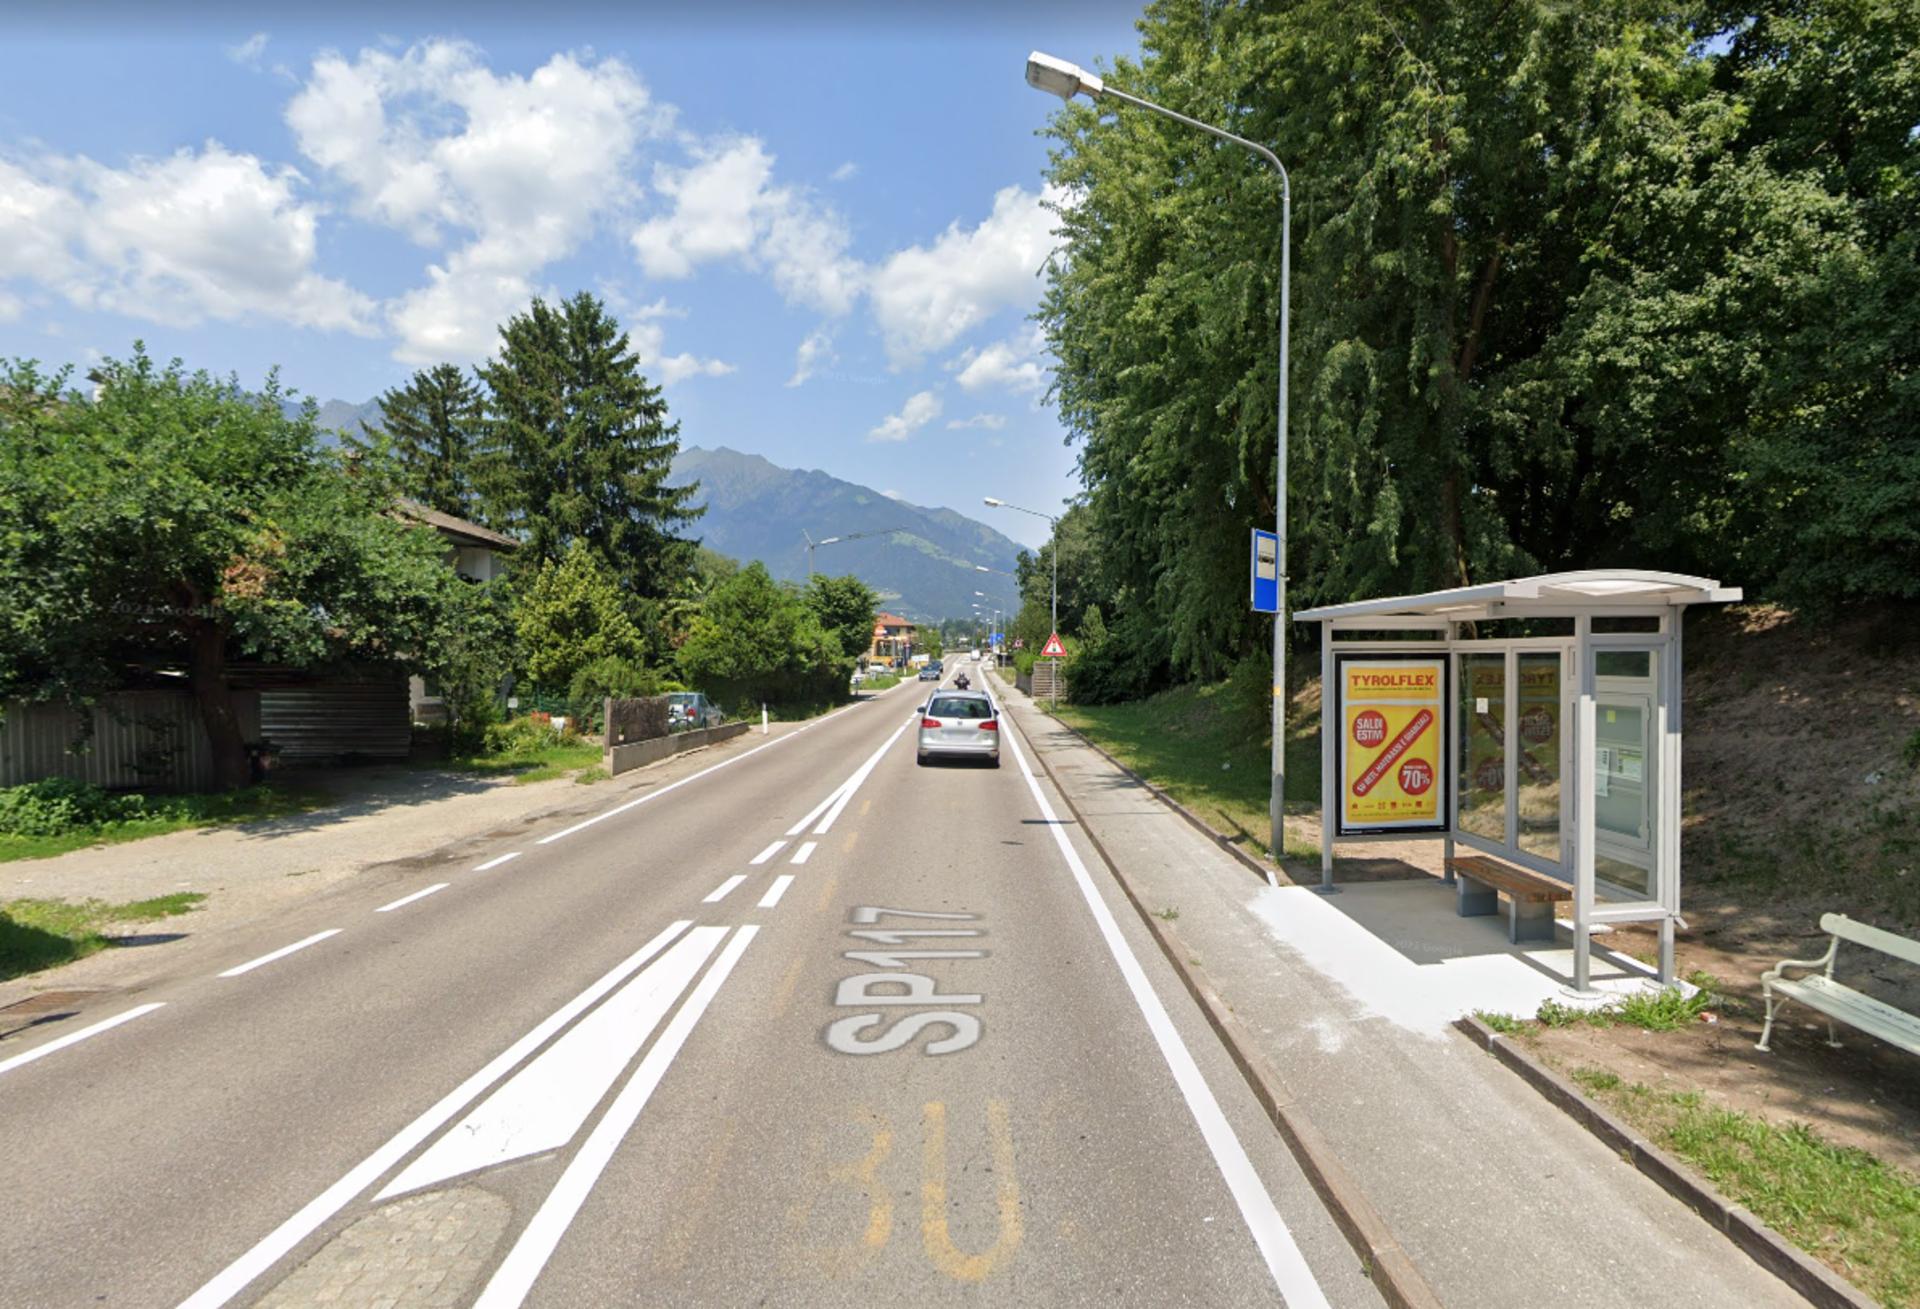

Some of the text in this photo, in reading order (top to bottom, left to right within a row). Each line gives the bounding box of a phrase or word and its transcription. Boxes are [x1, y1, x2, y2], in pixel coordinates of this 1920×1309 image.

[1351, 674, 1434, 686] TYROLFLEX
[1356, 718, 1383, 730] SALDI
[1402, 769, 1431, 789] 70%
